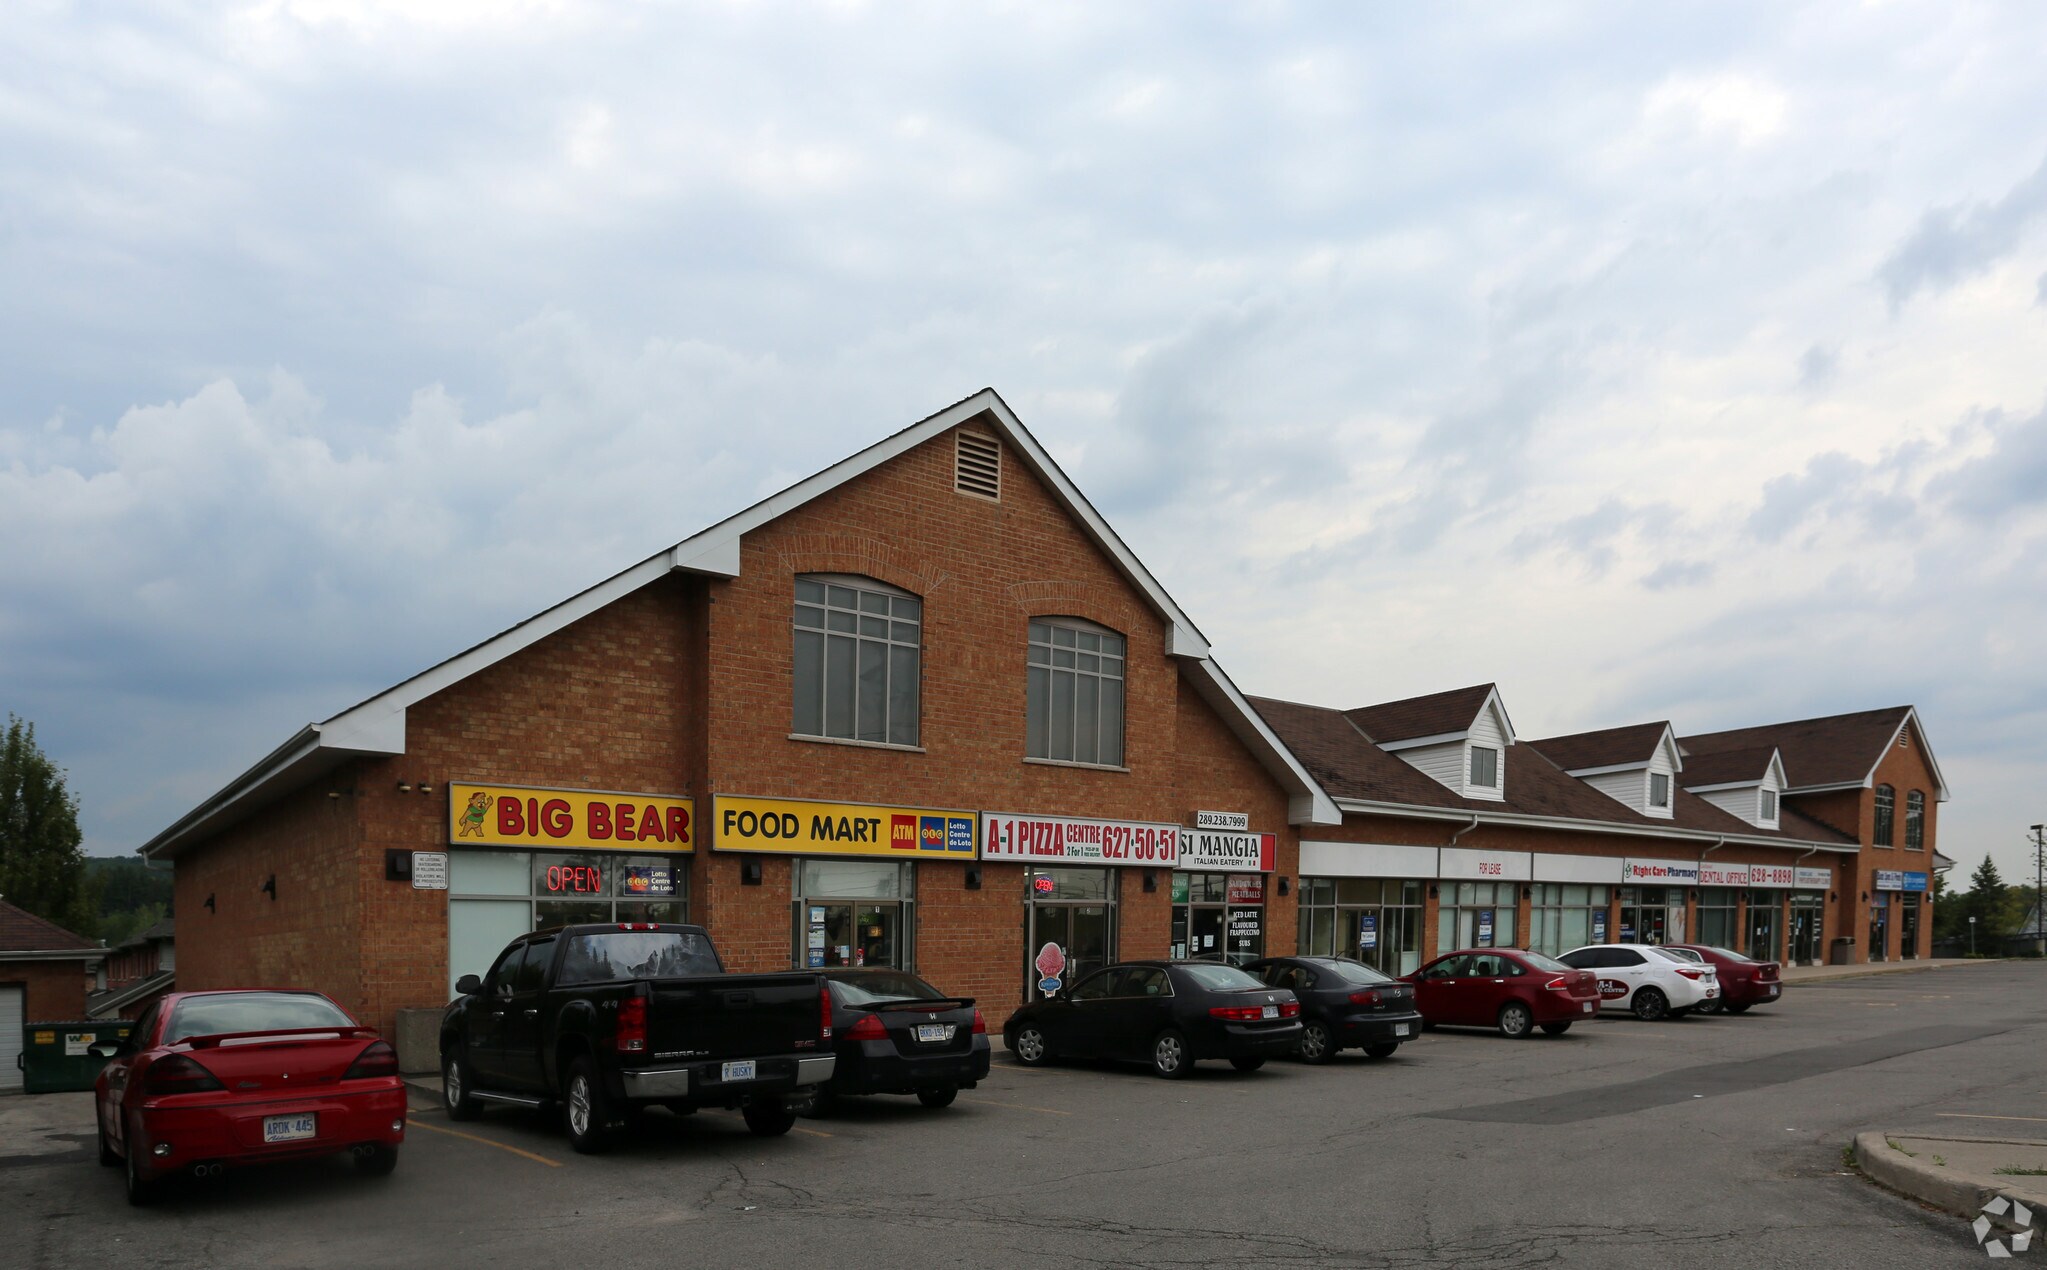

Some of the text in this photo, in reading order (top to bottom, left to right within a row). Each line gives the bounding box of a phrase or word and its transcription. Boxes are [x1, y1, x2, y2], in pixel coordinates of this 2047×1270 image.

[497, 796, 689, 843] BIG BEAR
[949, 822, 966, 830] Lotto
[1199, 814, 1246, 827] 289.238.7999
[724, 810, 881, 843] FOOD MART
[892, 824, 914, 840] ATM
[921, 829, 943, 839] OLG
[987, 819, 1013, 854] A-1
[1018, 821, 1064, 856] PIZZA
[1066, 823, 1100, 843] CENTRE
[1067, 846, 1070, 856] 2
[1071, 846, 1080, 857] For
[1200, 835, 1259, 858] MANGIA
[1194, 857, 1244, 867] ITALIAN EATERY
[1478, 862, 1501, 875] FOR LEASE
[1633, 865, 1651, 877] Right
[1652, 866, 1667, 877] Care
[1667, 866, 1698, 879] Pharmacy
[1700, 871, 1748, 884] DENTAL OFFICE
[1751, 868, 1792, 883] 628-8898
[547, 865, 601, 893] OPEN
[1238, 939, 1251, 947] SUBS
[1598, 980, 1613, 988] A-1
[732, 1065, 752, 1077] HUSKY
[295, 1119, 313, 1133] 445
